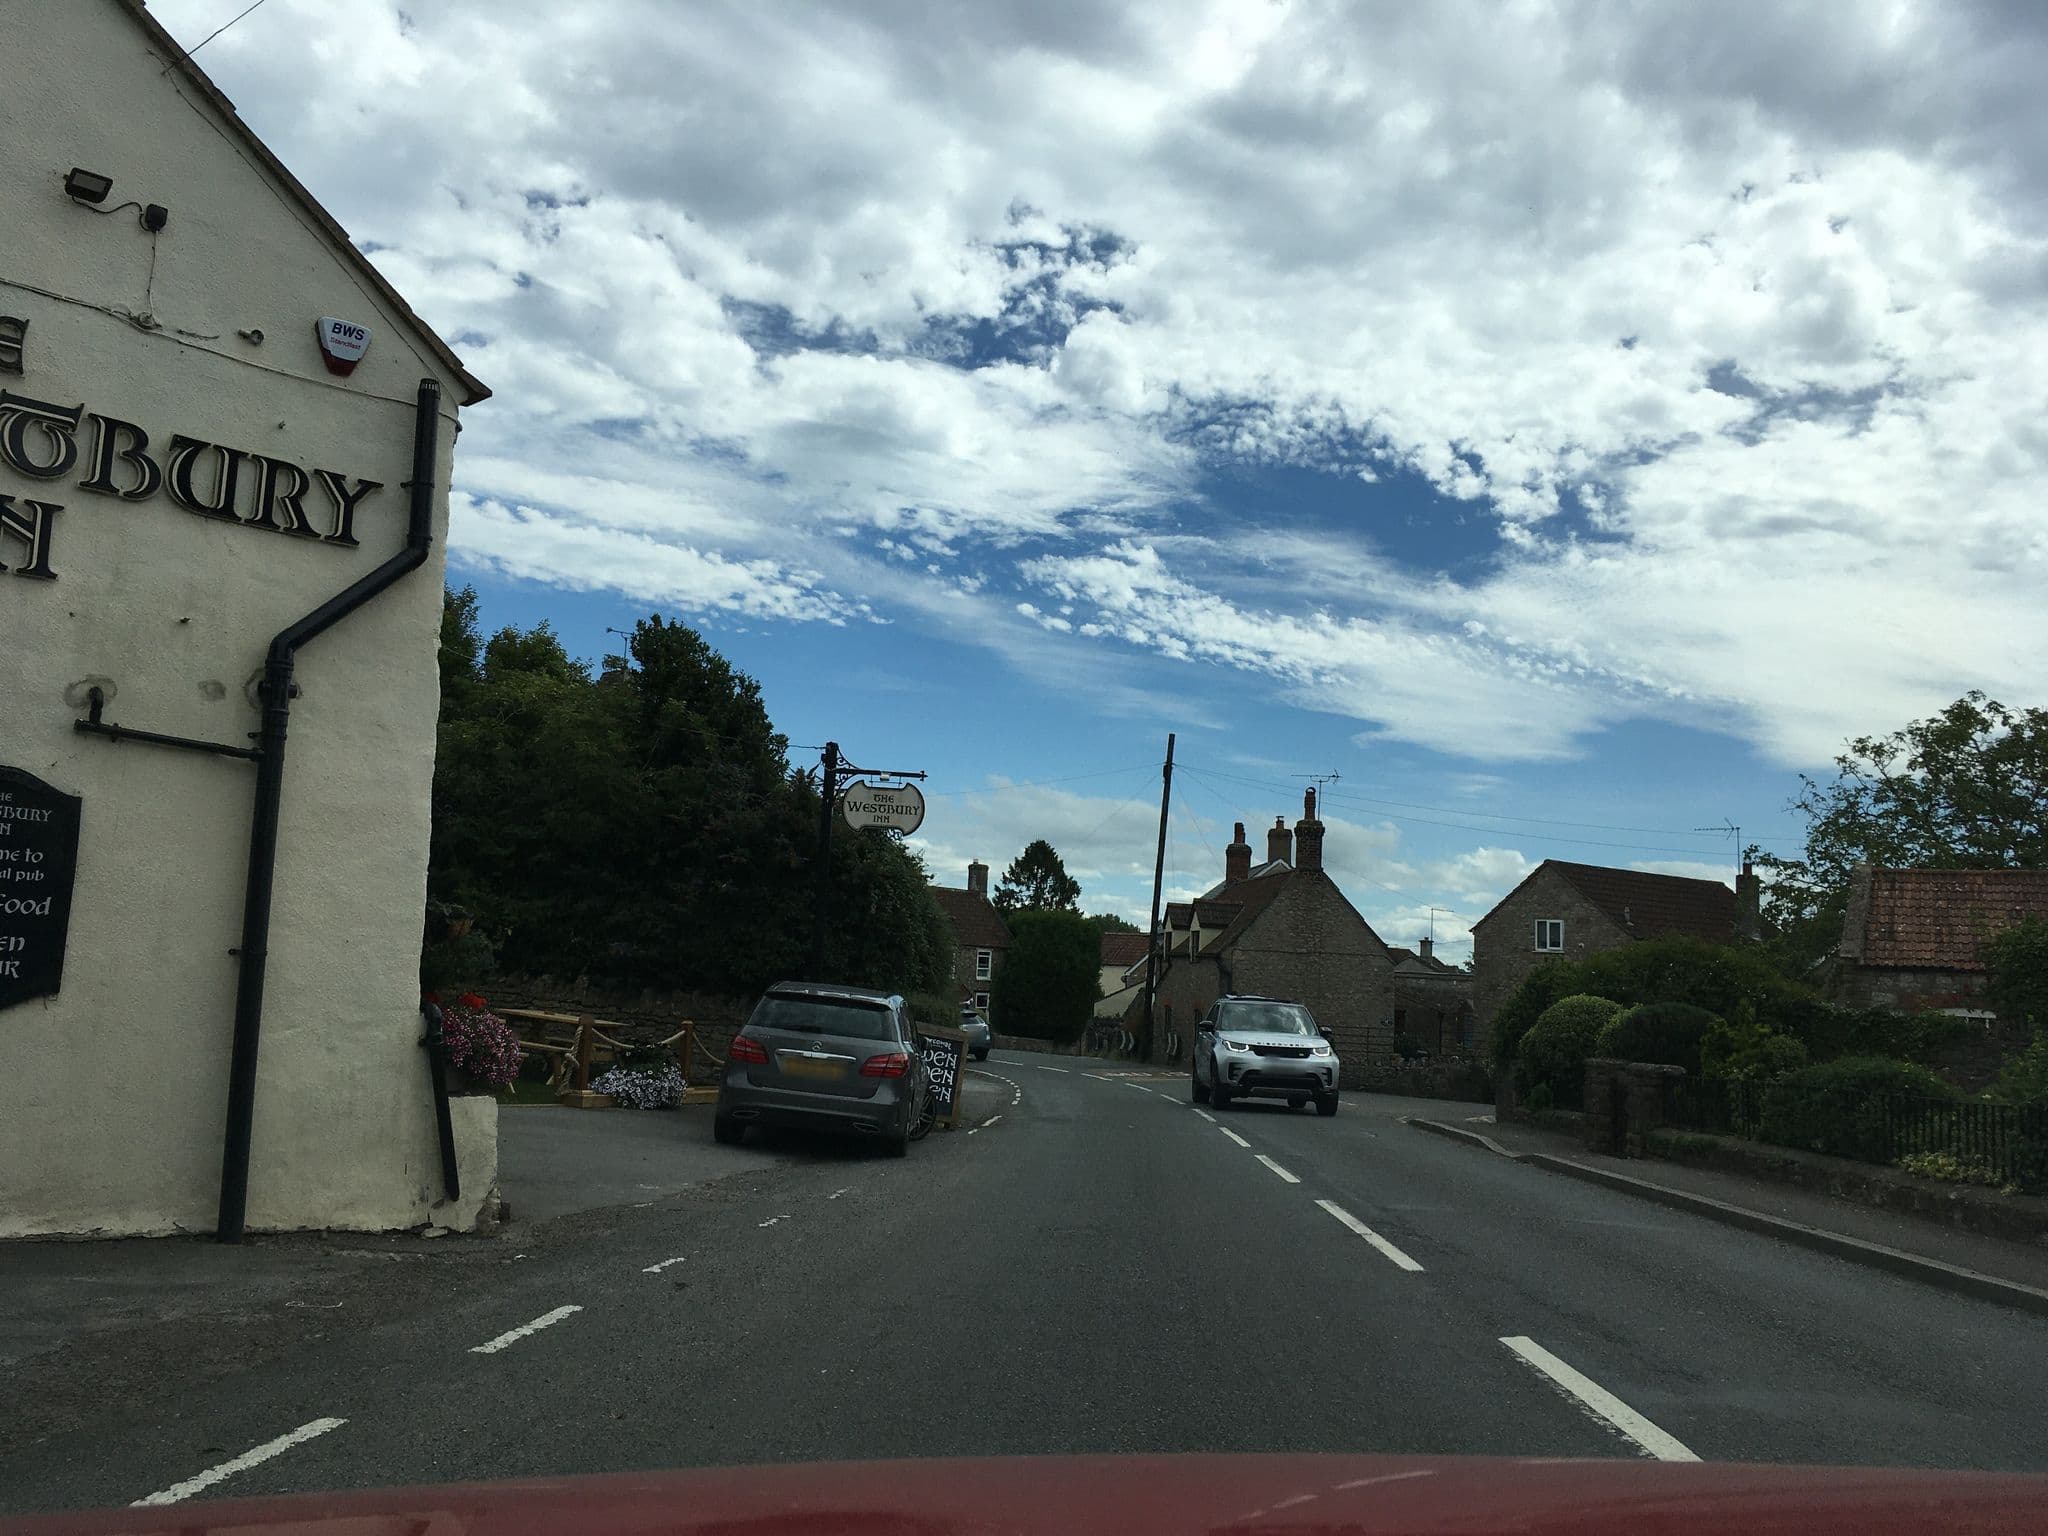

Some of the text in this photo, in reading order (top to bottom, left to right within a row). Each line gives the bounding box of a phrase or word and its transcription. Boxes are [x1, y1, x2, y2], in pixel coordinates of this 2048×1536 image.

[331, 322, 365, 340] BWS
[873, 794, 895, 804] THE
[873, 815, 890, 823] INN
[25, 848, 44, 863] to
[16, 869, 45, 882] pub
